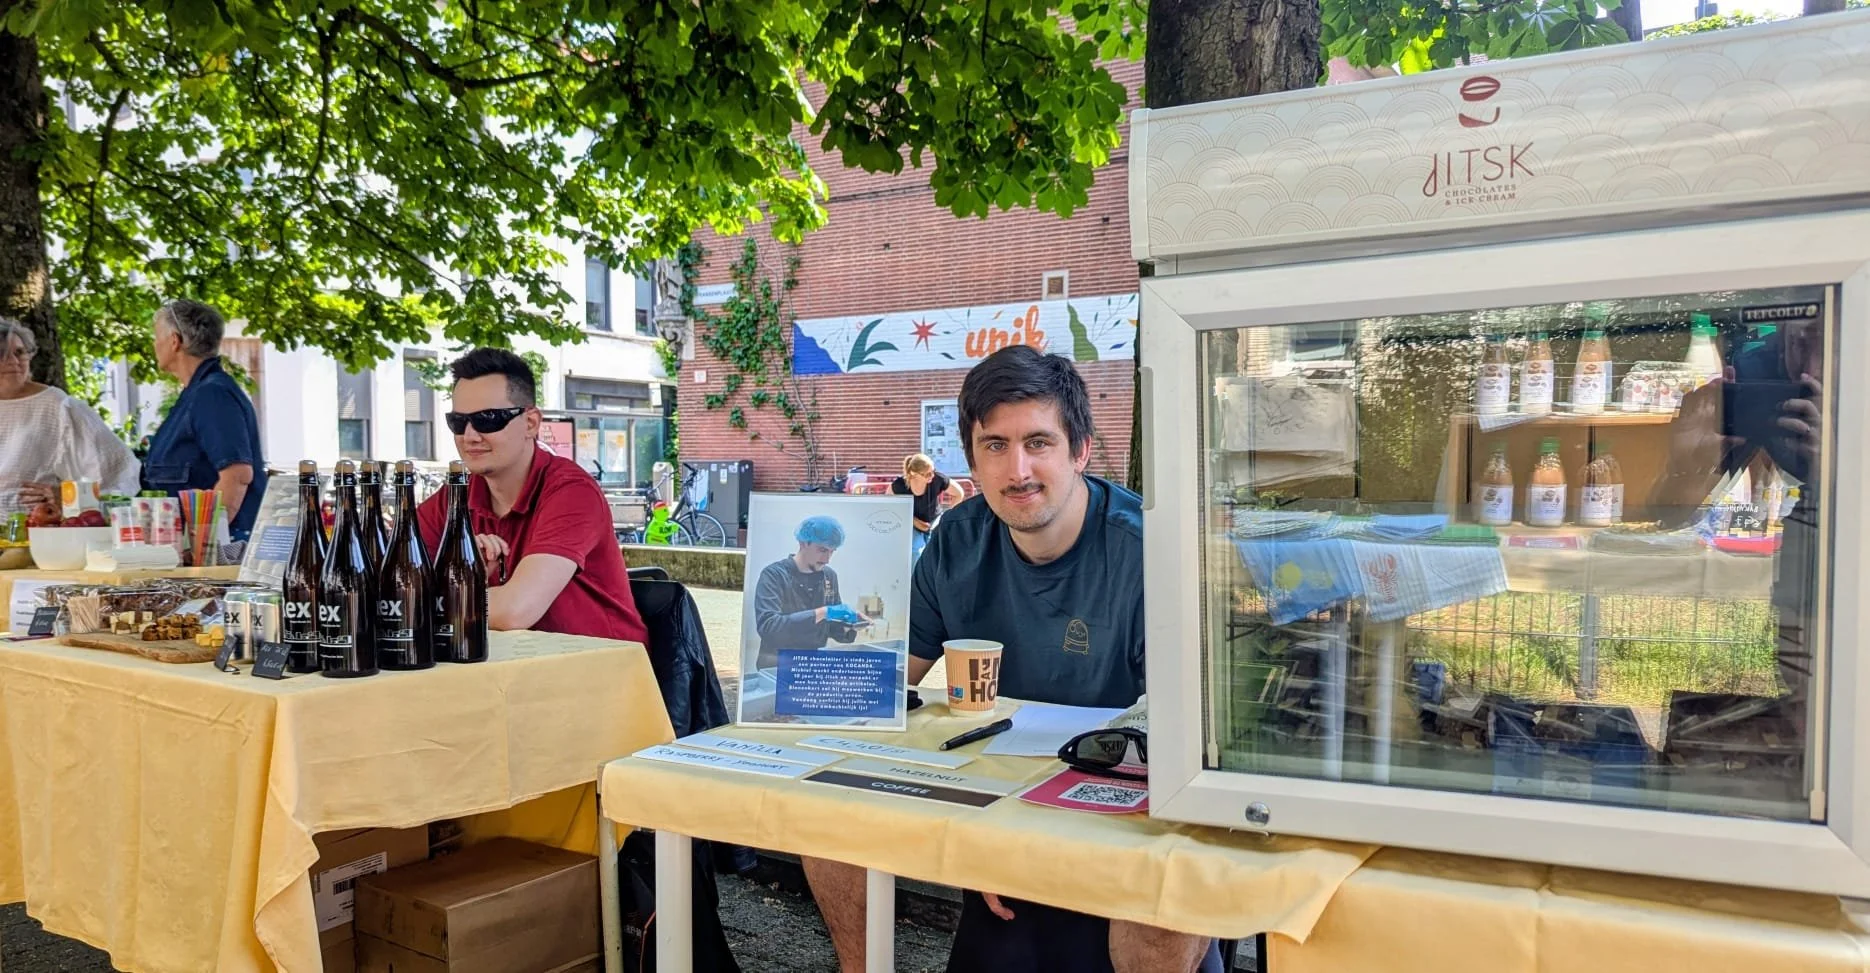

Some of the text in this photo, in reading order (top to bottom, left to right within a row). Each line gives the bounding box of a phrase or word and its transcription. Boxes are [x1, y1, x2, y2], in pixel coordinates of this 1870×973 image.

[1423, 142, 1534, 197] JITSK
[1445, 184, 1517, 198] CHOCOLATES
[1456, 196, 1475, 205] ICE
[1479, 192, 1516, 203] CREAM
[1744, 305, 1806, 319] TEFCOLD
[965, 304, 1049, 358] unik
[716, 740, 782, 755] VANILLA
[888, 766, 968, 783] HAZELNUT
[871, 781, 932, 795] COFFEE
